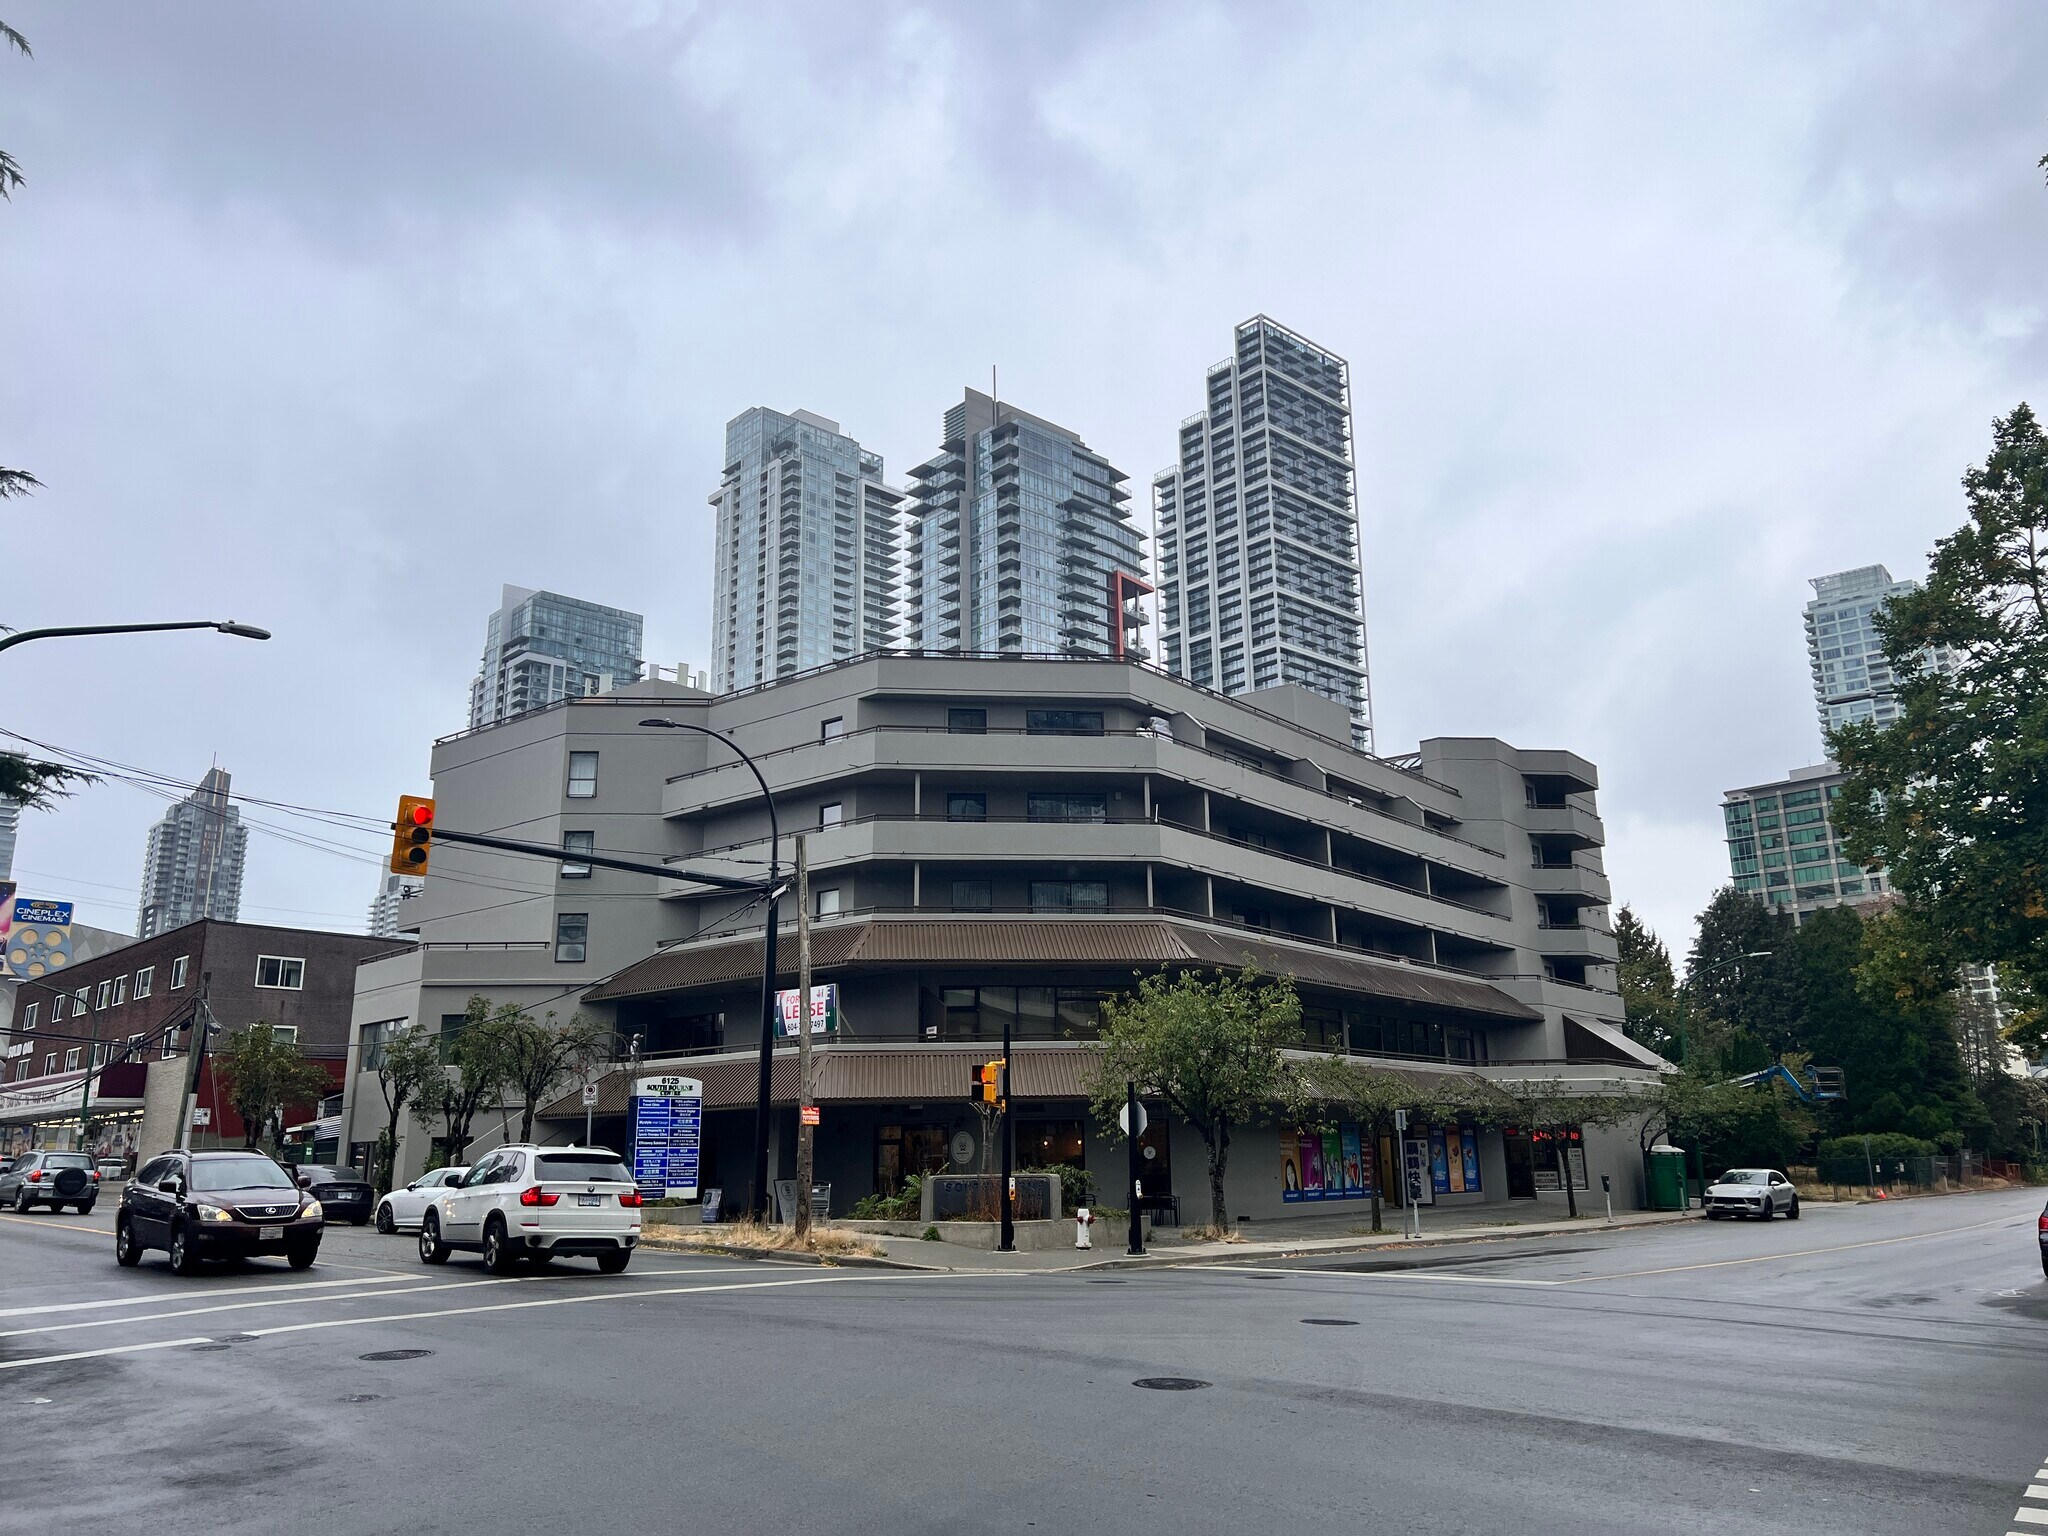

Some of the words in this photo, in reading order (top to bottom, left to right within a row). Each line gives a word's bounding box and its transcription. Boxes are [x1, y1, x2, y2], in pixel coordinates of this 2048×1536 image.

[16, 907, 70, 918] CINEPLEX
[21, 914, 63, 923] CINEMAS
[785, 1001, 824, 1020] LESE
[661, 1077, 680, 1085] 6125
